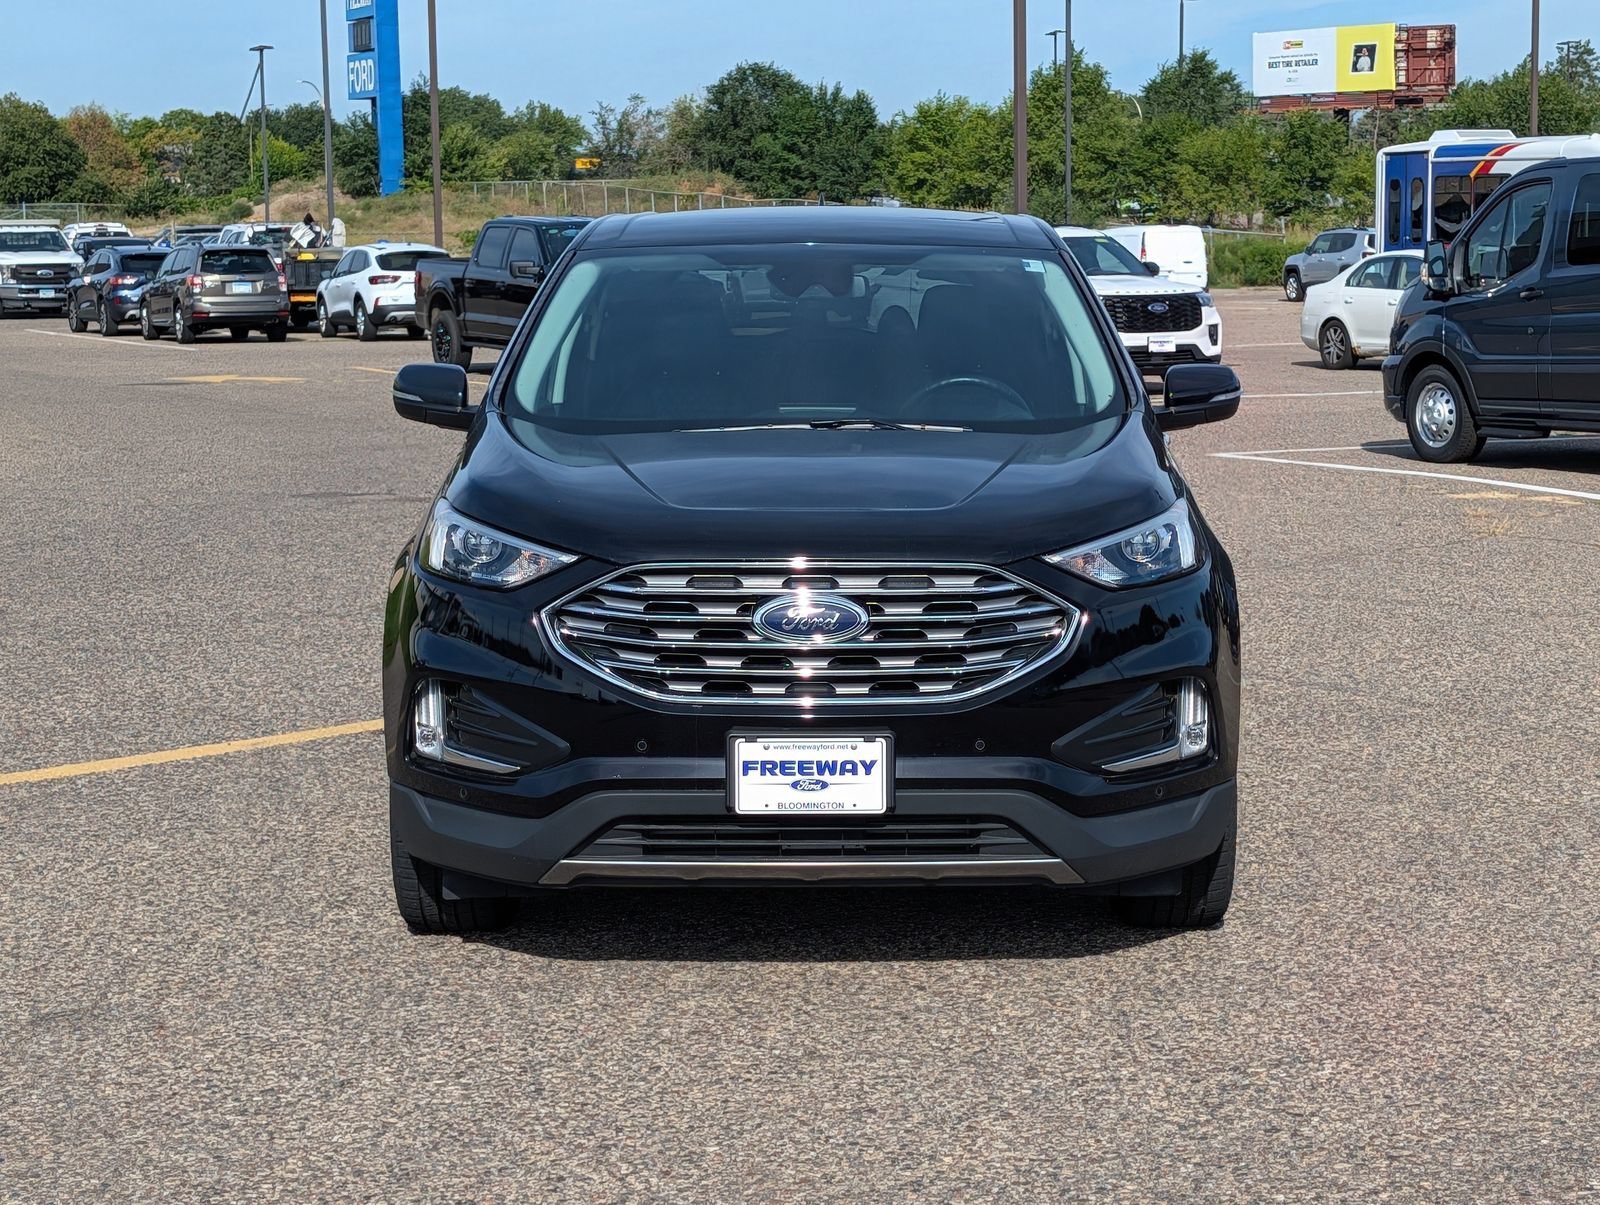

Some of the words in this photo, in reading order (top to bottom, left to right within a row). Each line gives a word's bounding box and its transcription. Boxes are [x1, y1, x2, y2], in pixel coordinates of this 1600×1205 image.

[1268, 61, 1280, 69] BEST
[1282, 60, 1293, 68] TIRE
[1294, 58, 1318, 67] RETAILER
[349, 59, 375, 93] FORD
[782, 607, 841, 630] Ford
[773, 743, 849, 751] www.freewayford.net
[742, 759, 878, 777] FREEWAY
[796, 779, 823, 791] Ford
[777, 802, 845, 810] BLOOMINGTON
